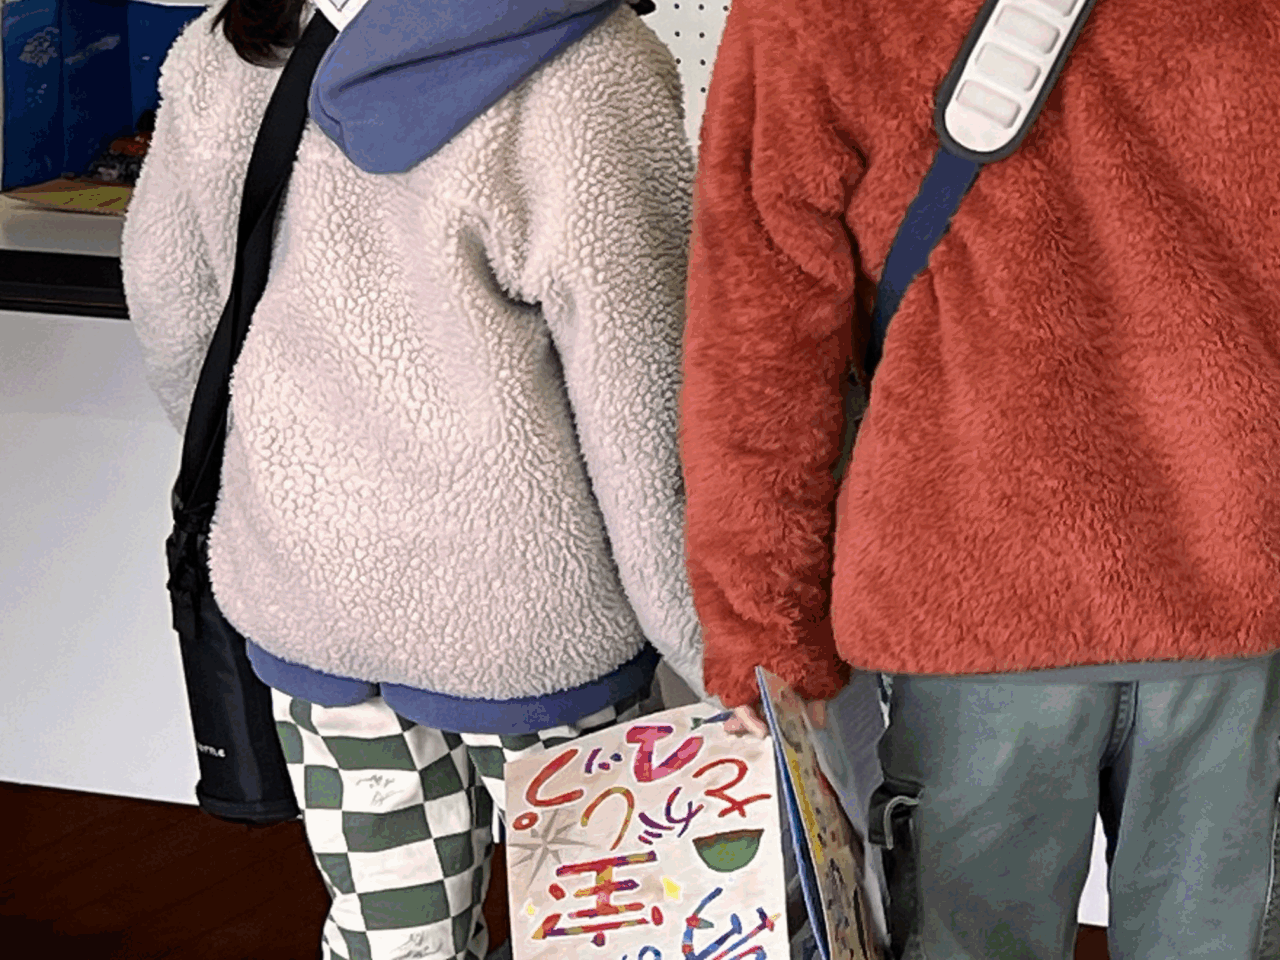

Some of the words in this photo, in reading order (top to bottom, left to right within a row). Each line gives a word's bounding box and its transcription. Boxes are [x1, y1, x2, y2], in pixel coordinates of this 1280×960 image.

[512, 725, 705, 830] マップ
[581, 758, 772, 851] さがし
[532, 851, 664, 947] 宝
